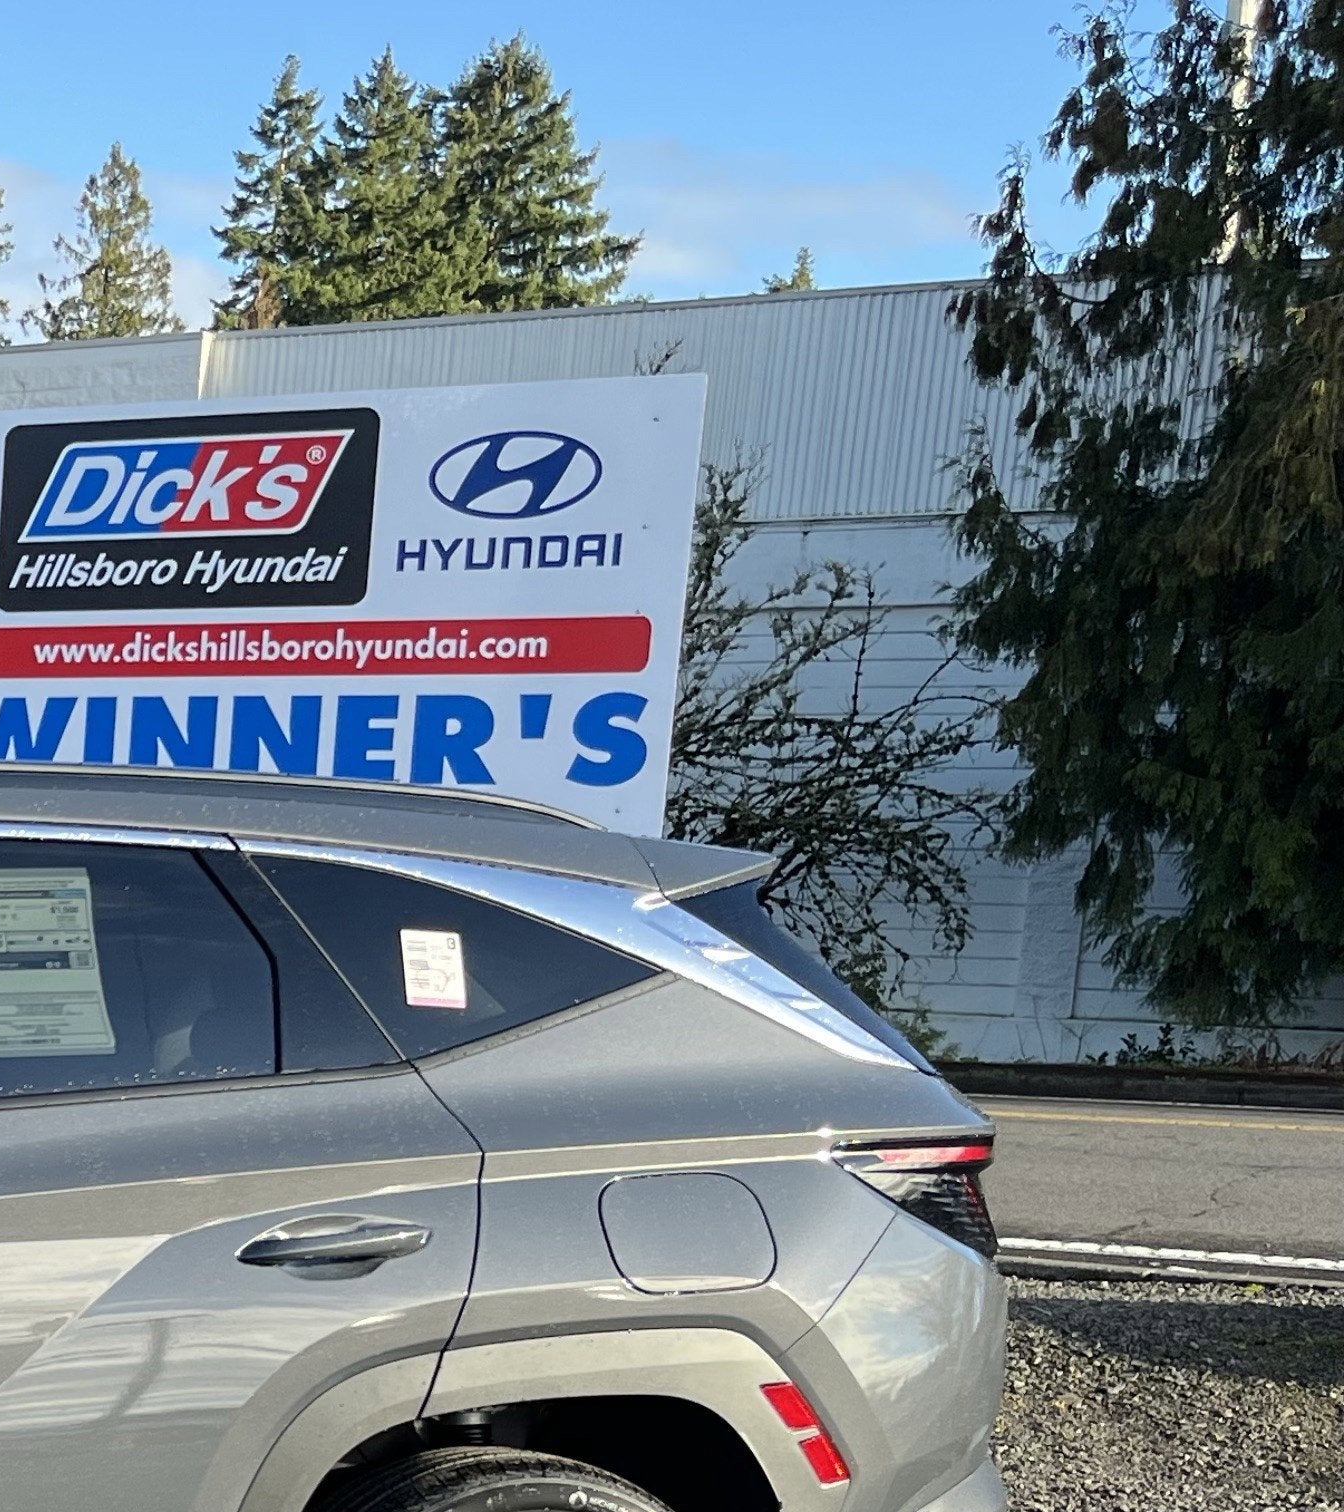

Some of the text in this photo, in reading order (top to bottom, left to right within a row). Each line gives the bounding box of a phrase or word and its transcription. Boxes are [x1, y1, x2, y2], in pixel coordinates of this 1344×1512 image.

[9, 546, 349, 594] Hillsboro Hyundai
[397, 532, 623, 572] HYUNDAI
[34, 630, 549, 673] www.dickshillsborohyundai.com
